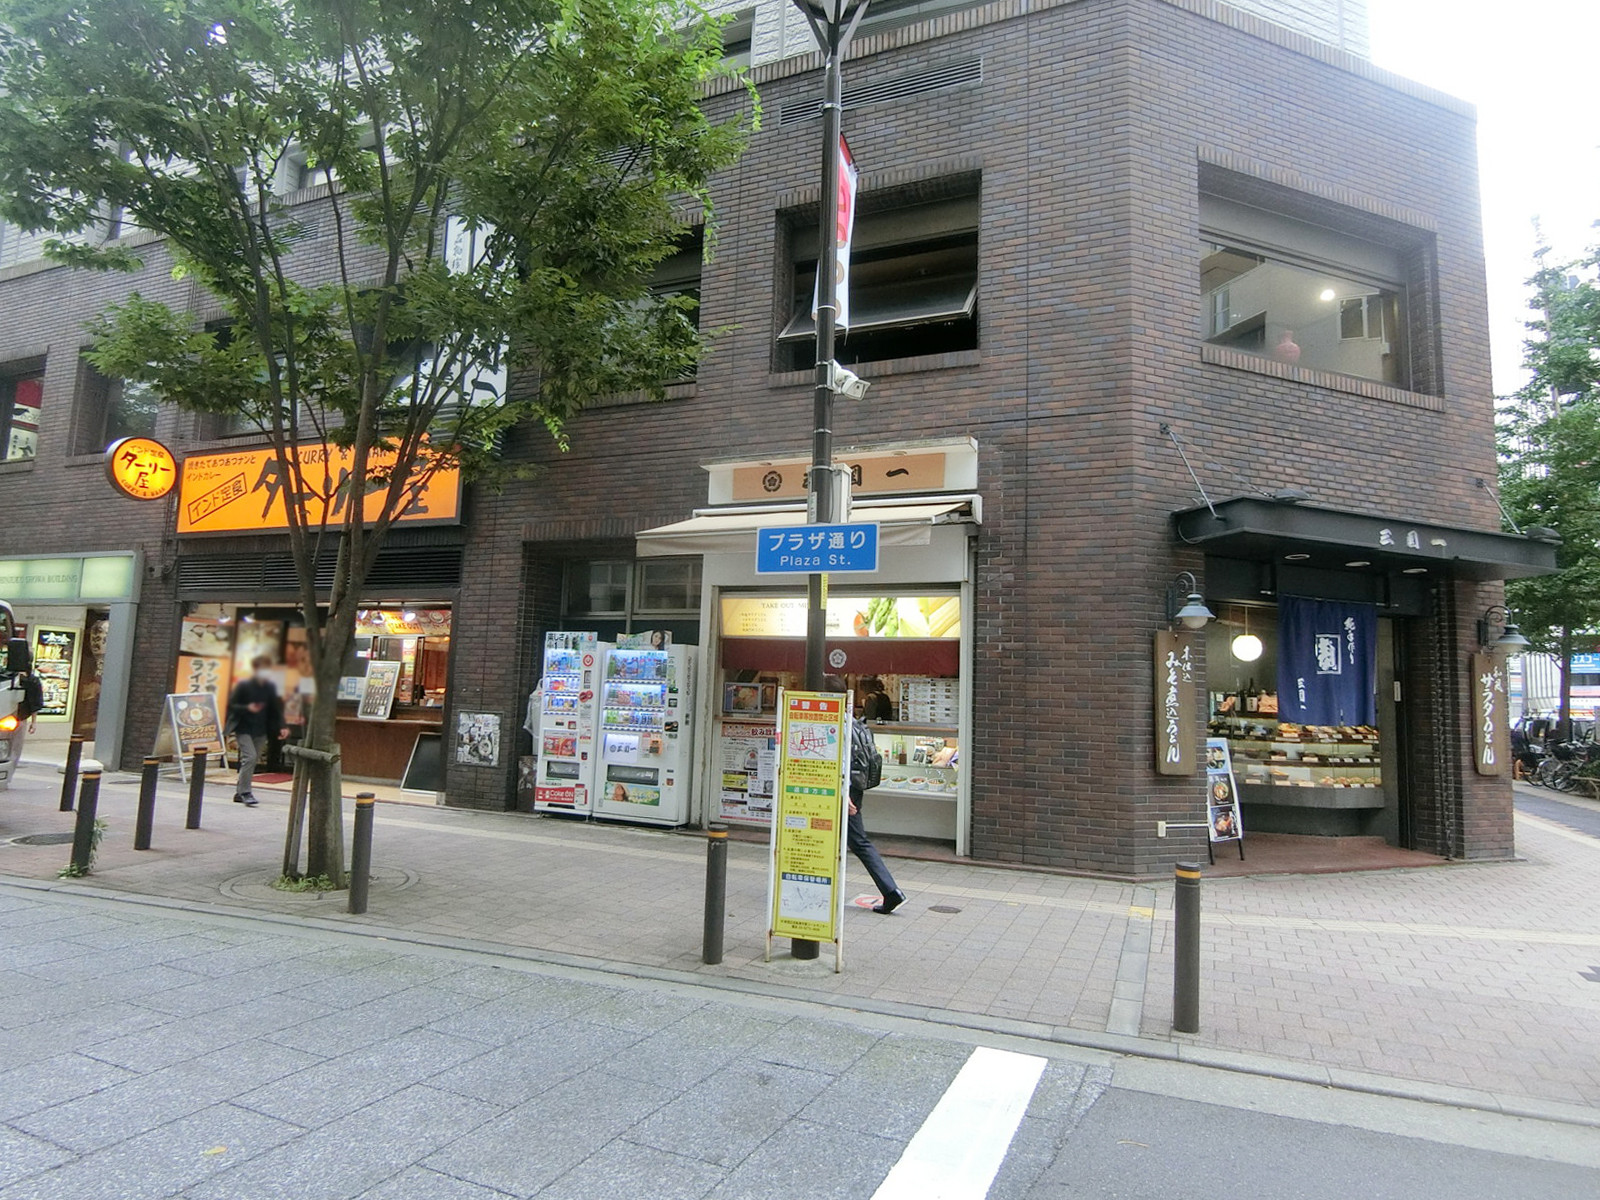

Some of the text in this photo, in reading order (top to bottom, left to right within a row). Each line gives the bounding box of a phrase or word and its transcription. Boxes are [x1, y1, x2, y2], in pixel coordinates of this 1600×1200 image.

[120, 450, 171, 475] ターリー
[135, 471, 149, 489] 屋
[192, 479, 243, 517] インド定食
[768, 531, 866, 552] プラザ通り
[780, 554, 851, 566] Plaza St.
